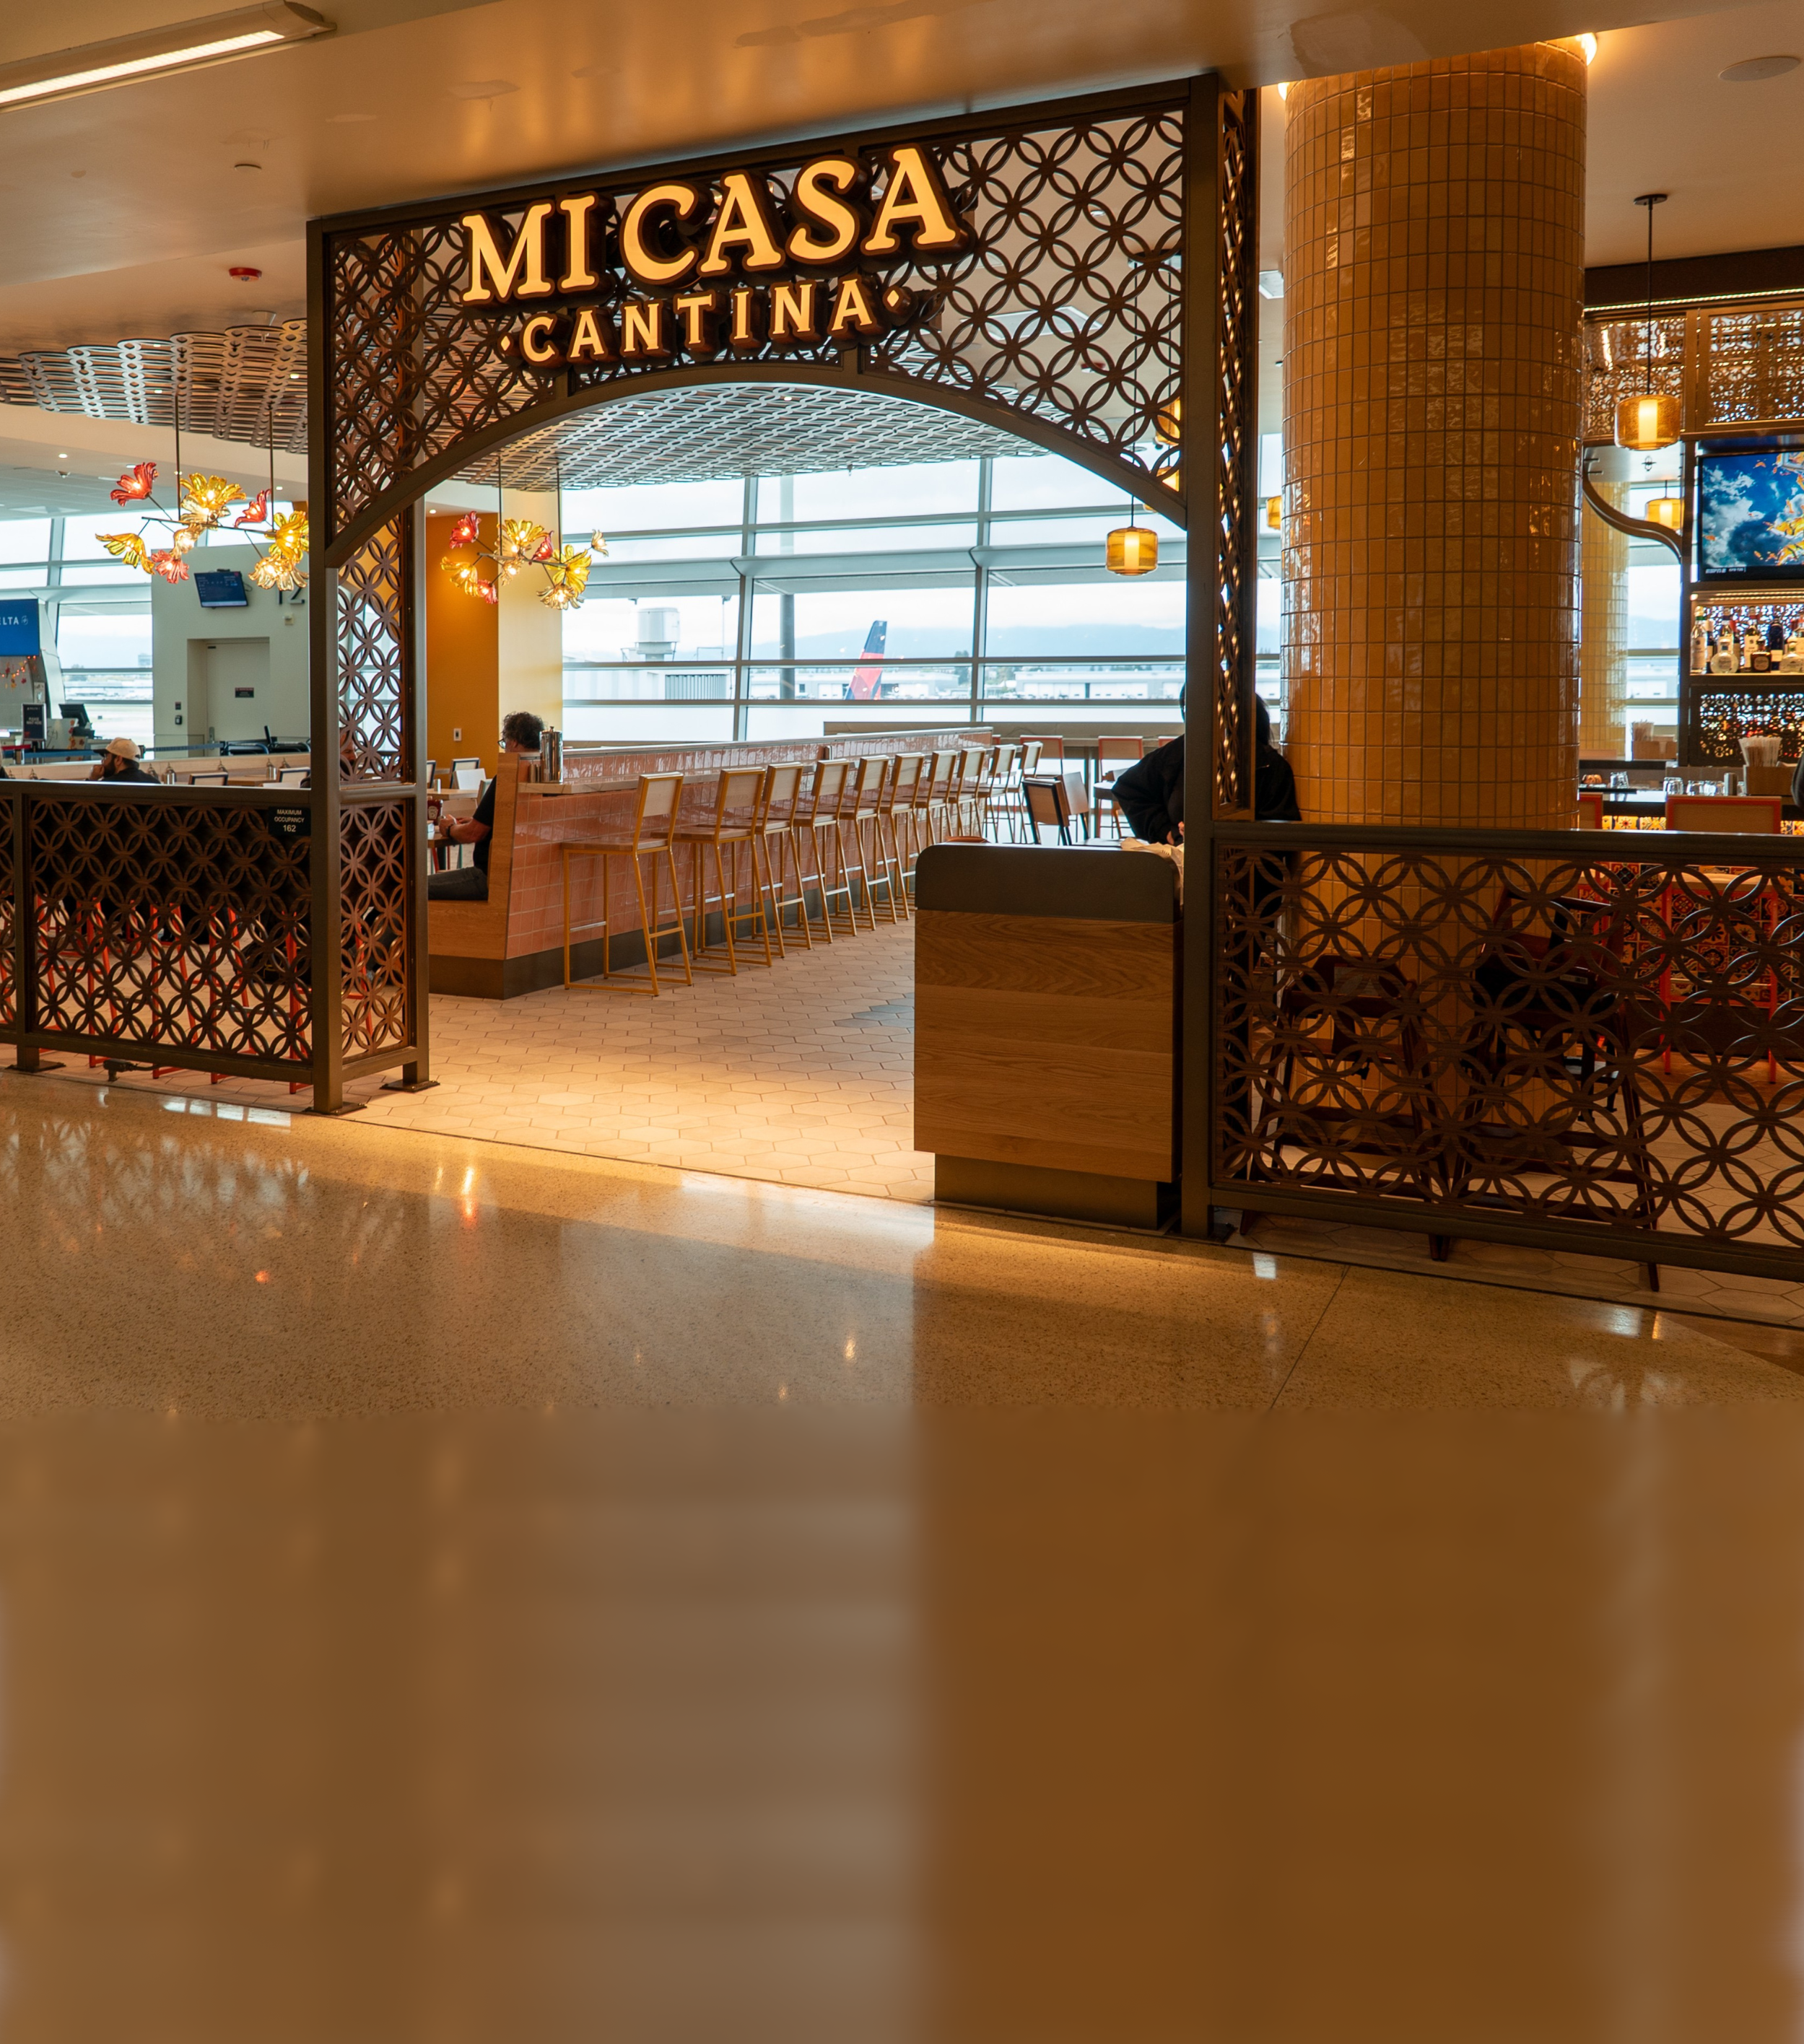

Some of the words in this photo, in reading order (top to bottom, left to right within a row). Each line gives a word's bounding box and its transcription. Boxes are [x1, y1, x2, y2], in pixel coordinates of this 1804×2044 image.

[461, 195, 596, 302] MI
[623, 147, 957, 281] CASA
[523, 278, 873, 362] CANTINA
[0, 616, 19, 625] LTA
